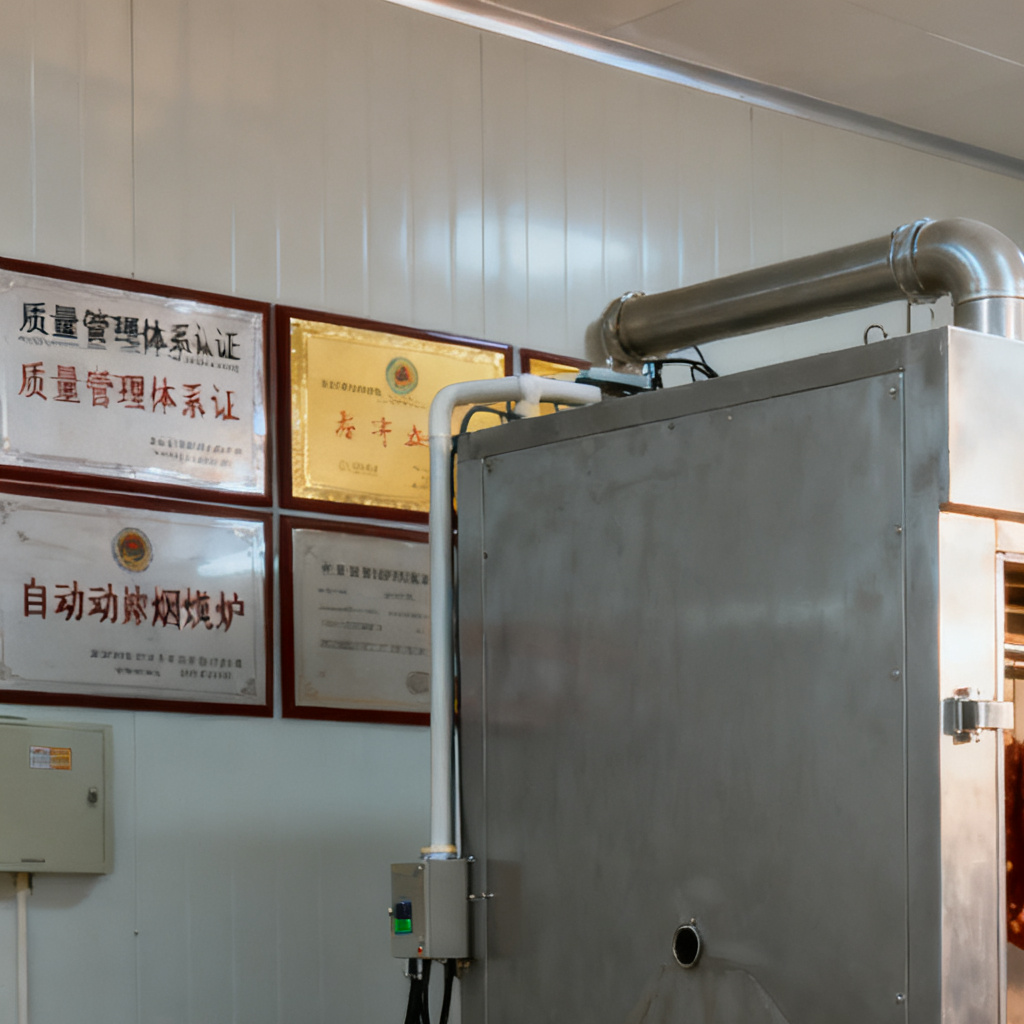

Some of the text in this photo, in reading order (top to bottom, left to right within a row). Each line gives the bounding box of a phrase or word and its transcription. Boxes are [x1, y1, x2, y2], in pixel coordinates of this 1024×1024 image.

[20, 302, 240, 361] 质量管理体系认证
[18, 361, 240, 421] 质量管理体系证
